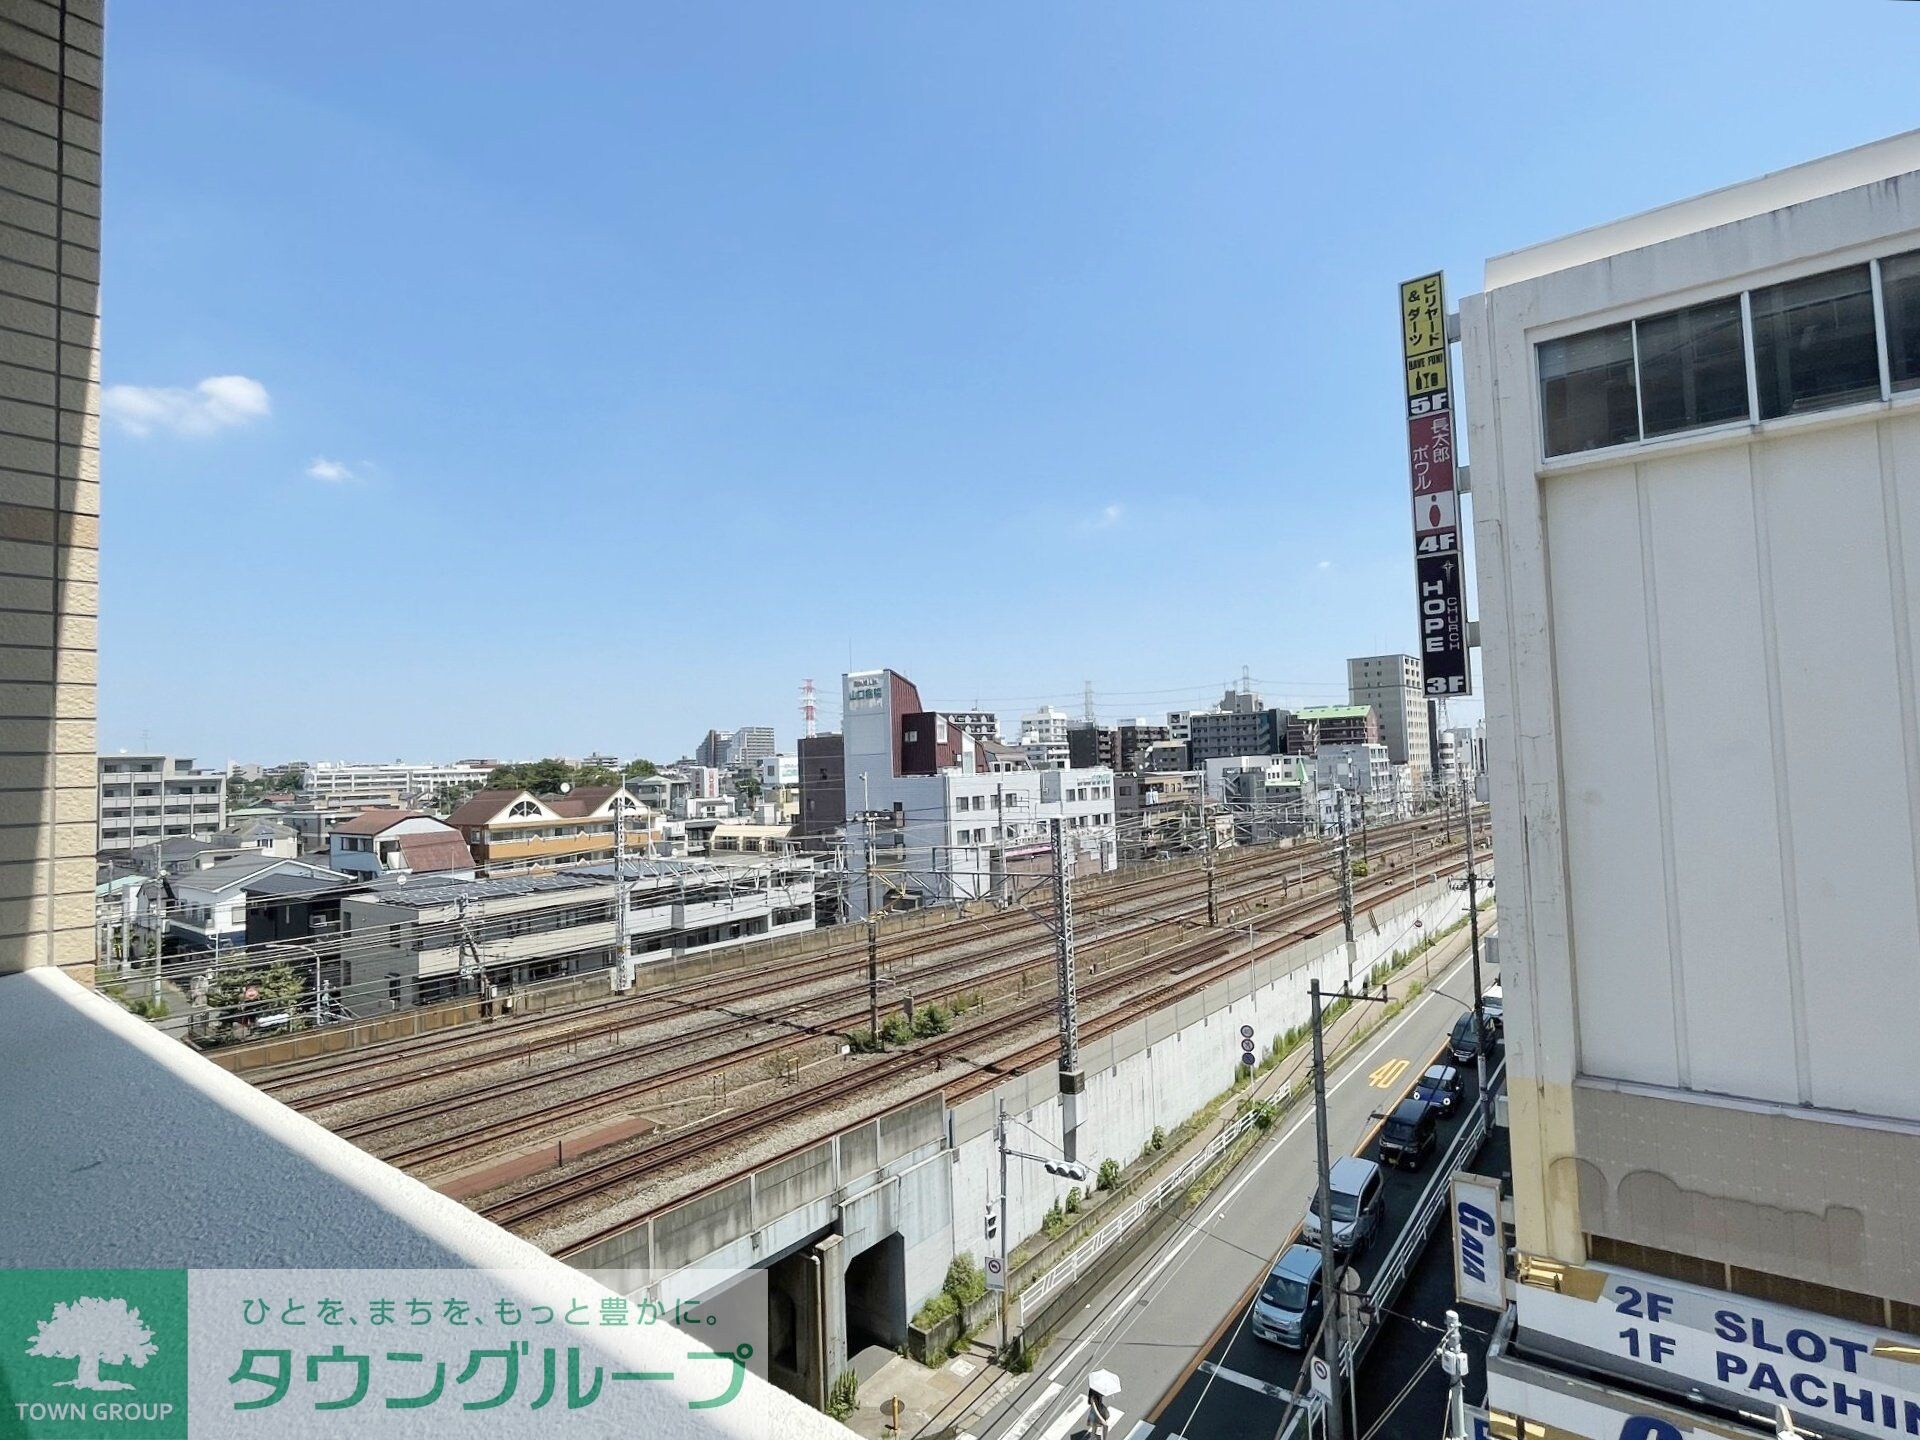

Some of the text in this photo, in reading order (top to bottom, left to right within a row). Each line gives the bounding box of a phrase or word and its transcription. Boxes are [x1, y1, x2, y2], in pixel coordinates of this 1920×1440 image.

[1424, 281, 1440, 347] ビリヤード
[1408, 357, 1425, 371] HAVE
[1411, 393, 1448, 414] 5F
[1431, 418, 1450, 463] 長太郎
[1413, 445, 1432, 491] ボウル
[1418, 533, 1455, 552] 4F
[1423, 579, 1446, 653] HOPE
[1447, 597, 1460, 650] CHURCH
[1426, 676, 1464, 694] 3F
[1368, 1058, 1410, 1089] 40
[1615, 1285, 1868, 1374] 2F SLOT
[1619, 1327, 1676, 1364] 1F
